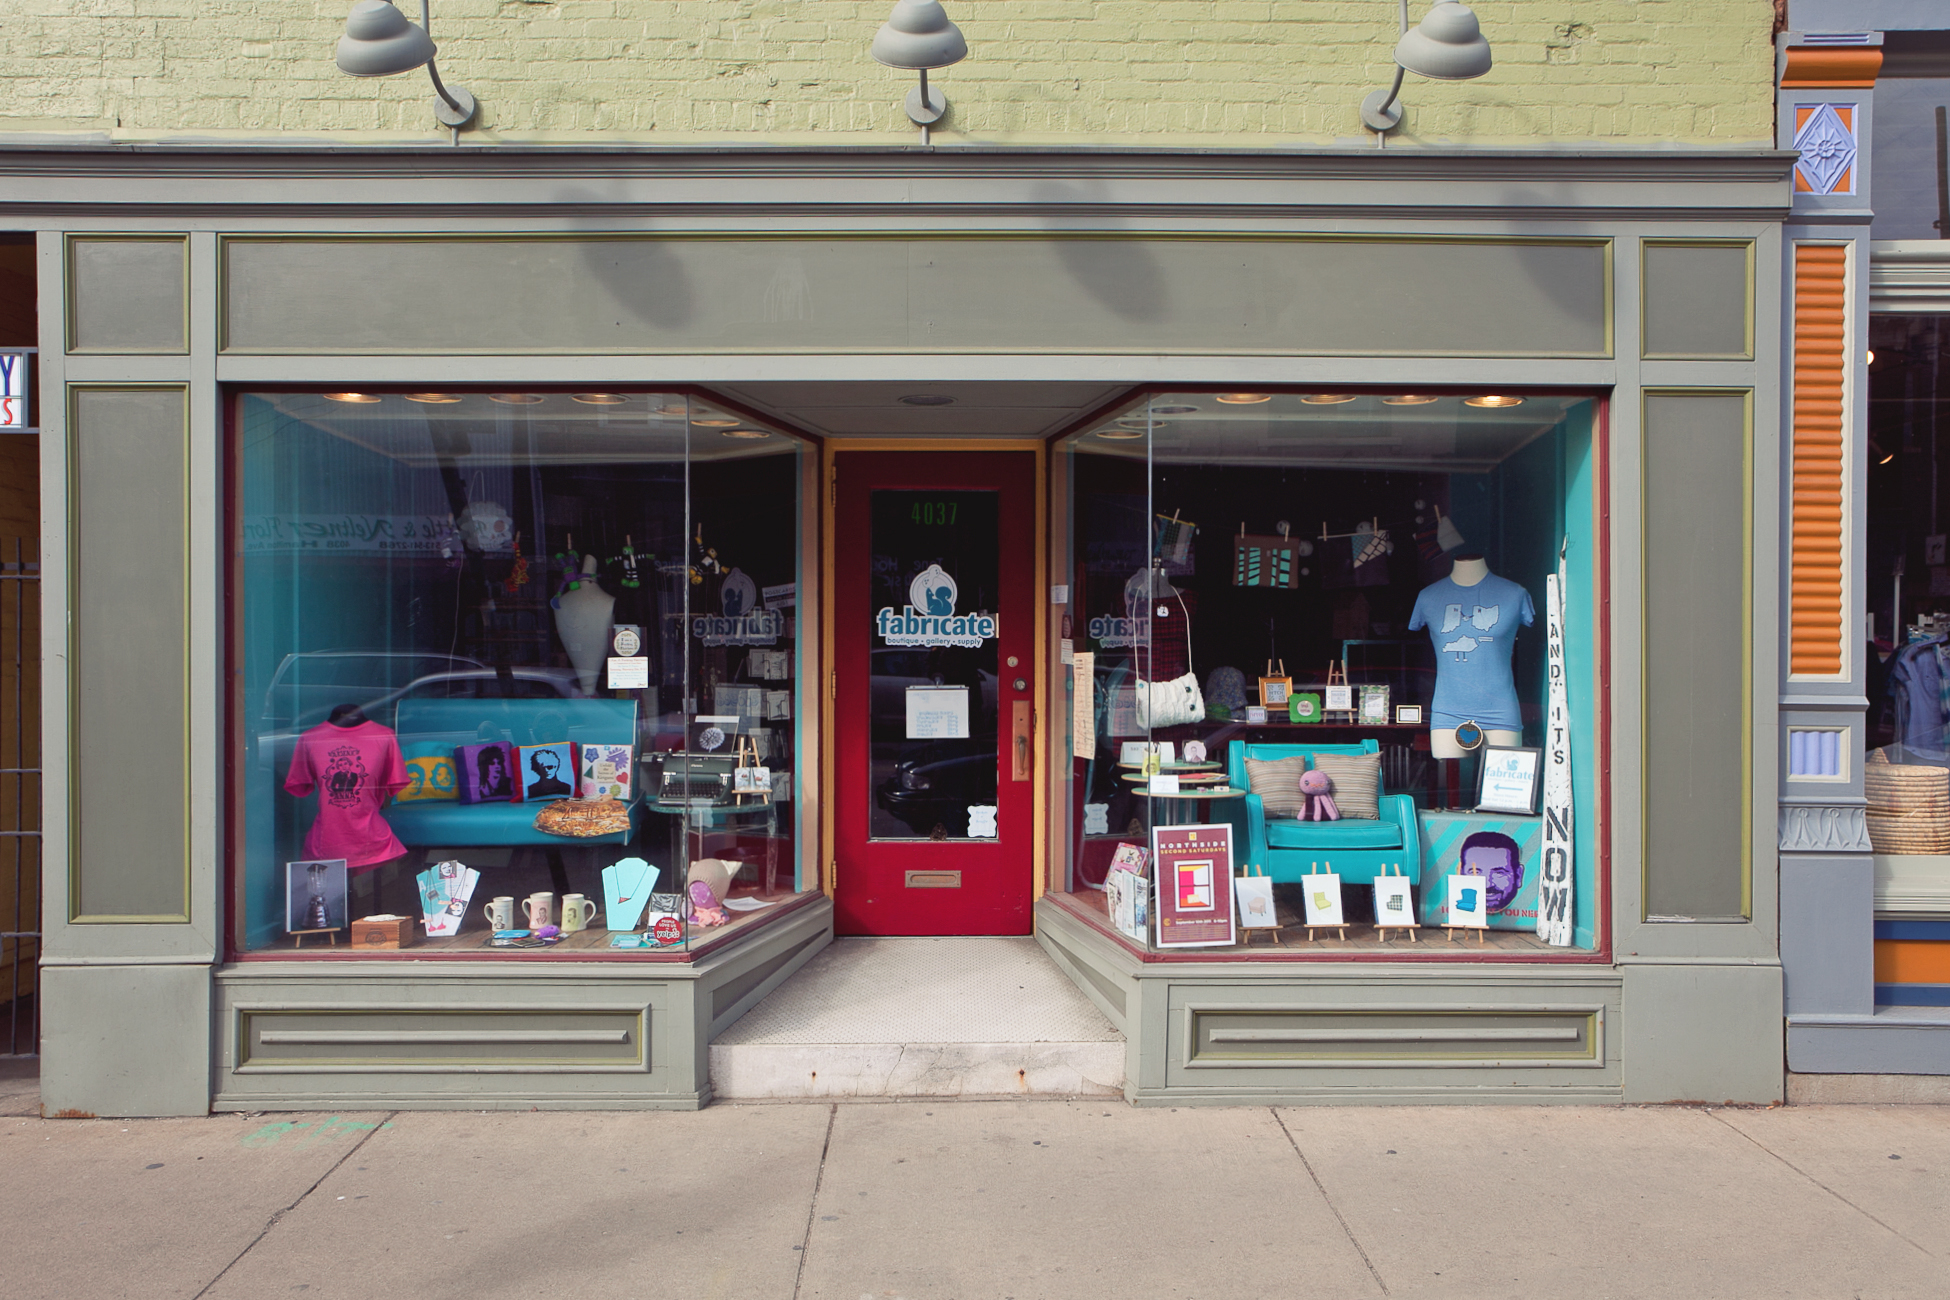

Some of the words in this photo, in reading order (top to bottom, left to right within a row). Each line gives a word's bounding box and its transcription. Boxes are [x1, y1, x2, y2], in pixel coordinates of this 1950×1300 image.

[3, 398, 13, 425] S
[911, 502, 958, 525] 4037
[878, 607, 992, 636] fabricate
[887, 637, 919, 645] boutique
[957, 638, 981, 646] supply
[1549, 622, 1561, 679] AND
[1553, 706, 1564, 765] ITS
[1485, 766, 1534, 781] fabricate
[1160, 840, 1226, 849] NORTHSIDE
[1542, 806, 1569, 922] NOW
[1499, 908, 1520, 917] YOU
[1521, 909, 1539, 918] NEE
[656, 930, 673, 940] yelp
